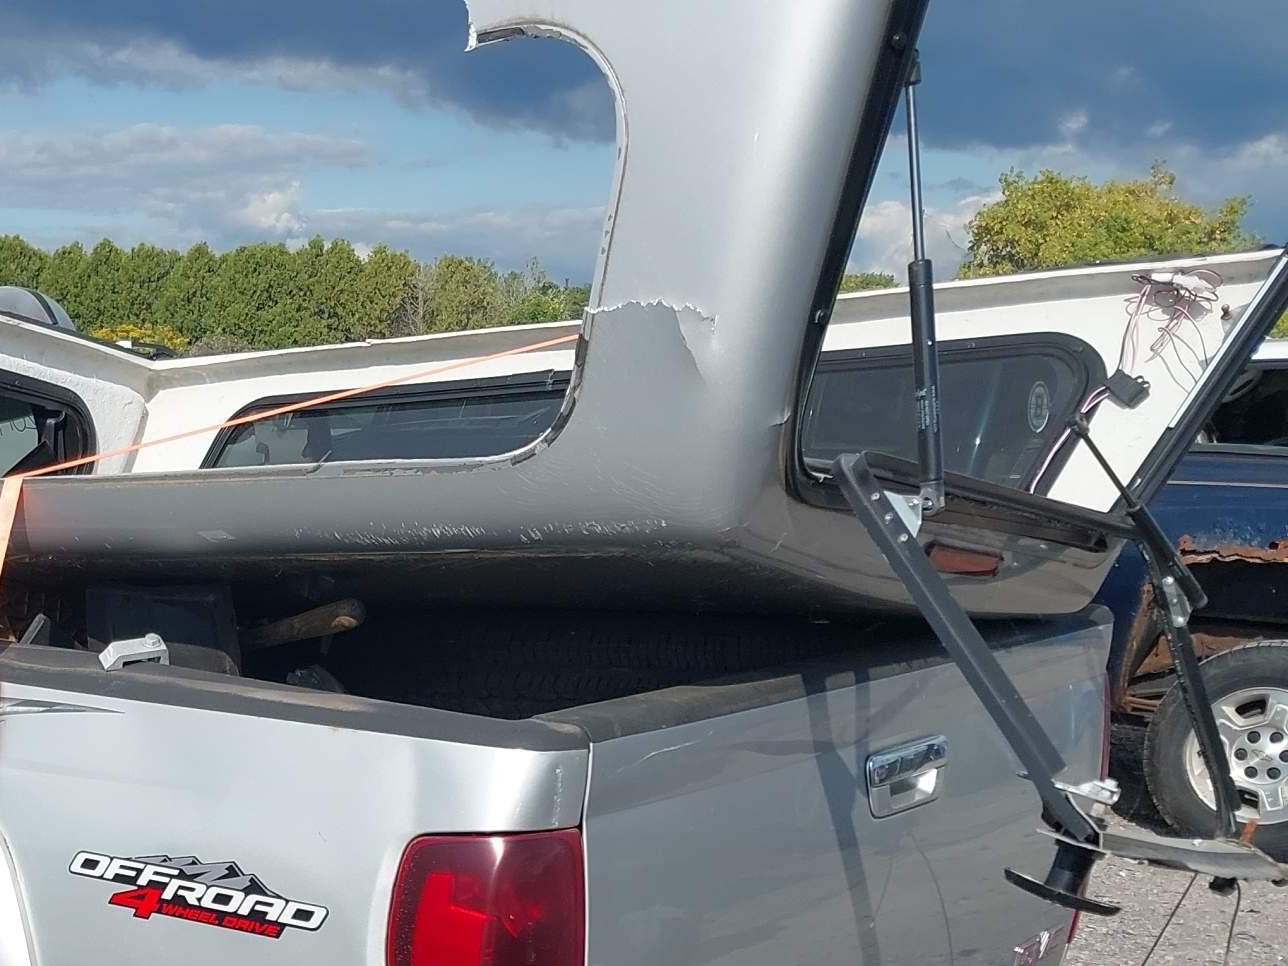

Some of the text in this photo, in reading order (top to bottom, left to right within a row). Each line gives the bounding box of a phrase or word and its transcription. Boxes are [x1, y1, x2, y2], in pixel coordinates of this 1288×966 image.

[111, 887, 281, 937] 4 WHEEL DRIVE
